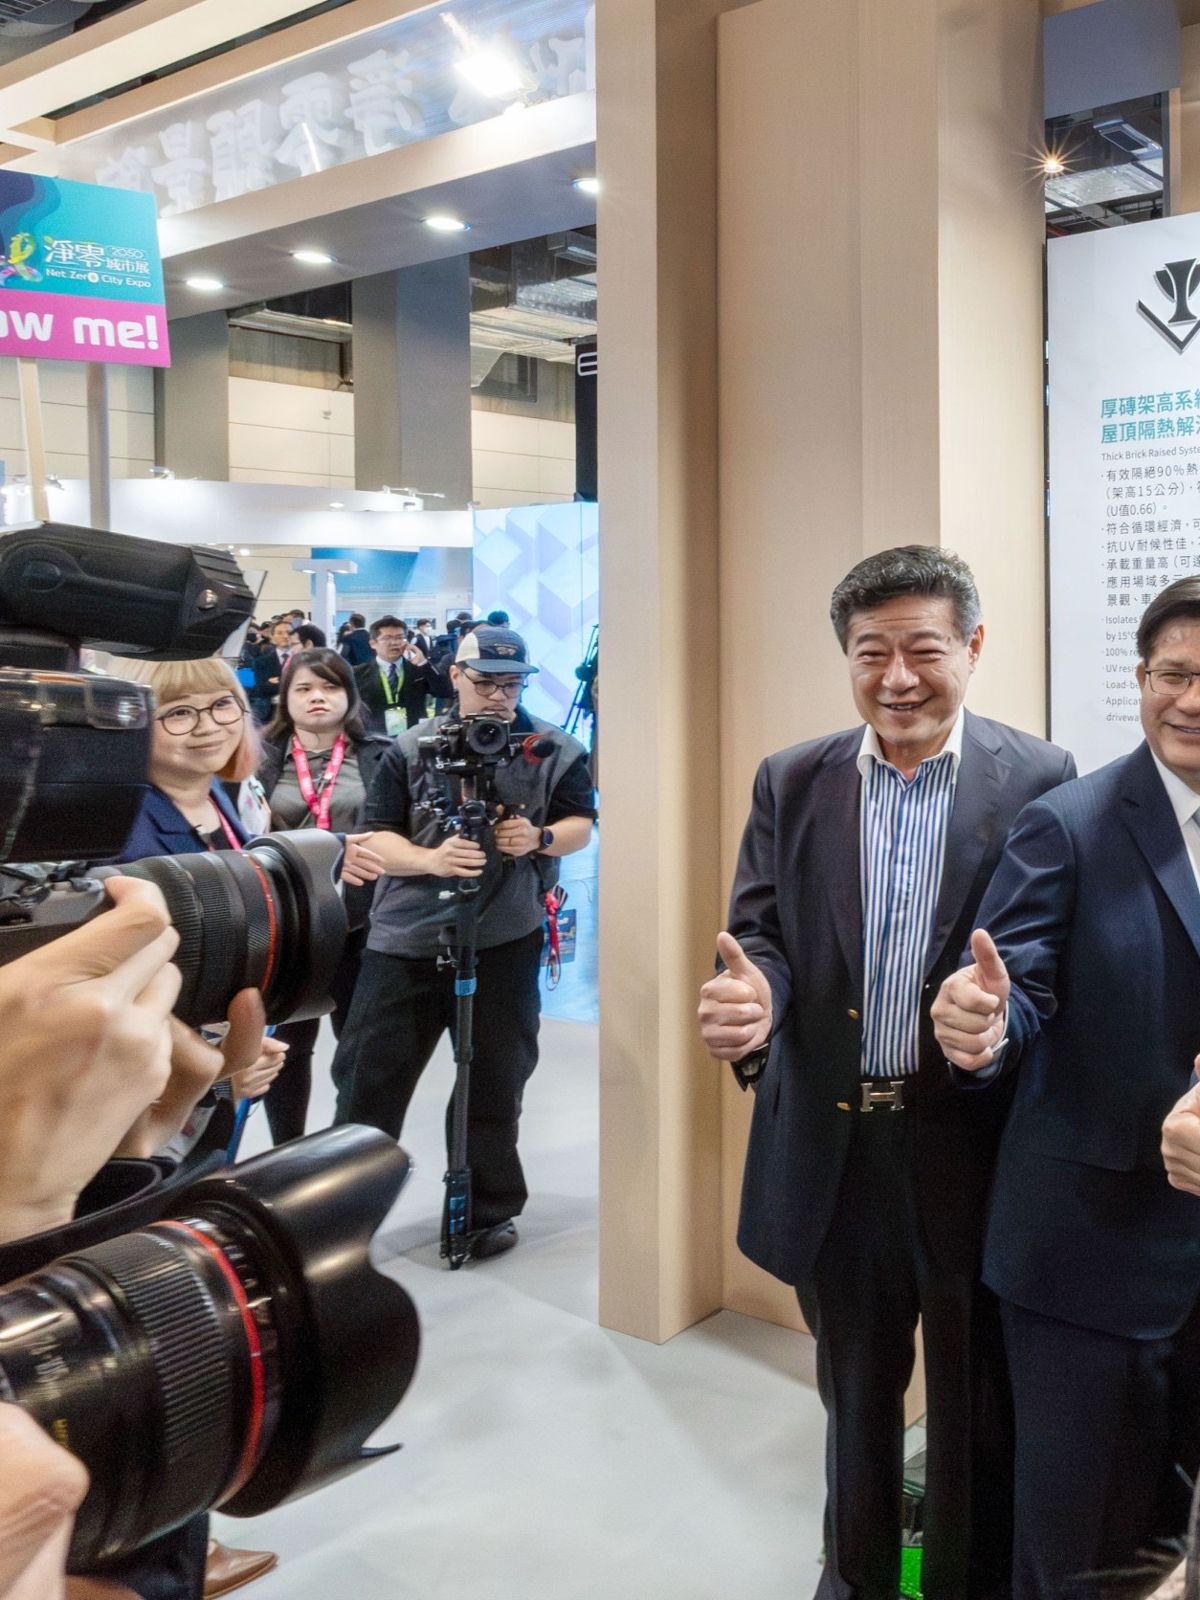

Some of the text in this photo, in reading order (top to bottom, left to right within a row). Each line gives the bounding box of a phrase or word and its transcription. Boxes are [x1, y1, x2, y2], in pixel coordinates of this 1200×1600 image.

[43, 240, 105, 267] 淨零
[46, 268, 67, 278] Net
[101, 274, 123, 285] City
[126, 278, 152, 288] Expo
[73, 315, 159, 350] me!
[1101, 451, 1124, 462] Thick
[1125, 449, 1147, 460] Brick
[1148, 445, 1177, 458] Raised
[1105, 615, 1138, 625] Isolates
[1105, 631, 1116, 642] by
[1105, 647, 1128, 657] 100%
[1105, 664, 1118, 673] UV
[1105, 712, 1140, 722] drivewa
